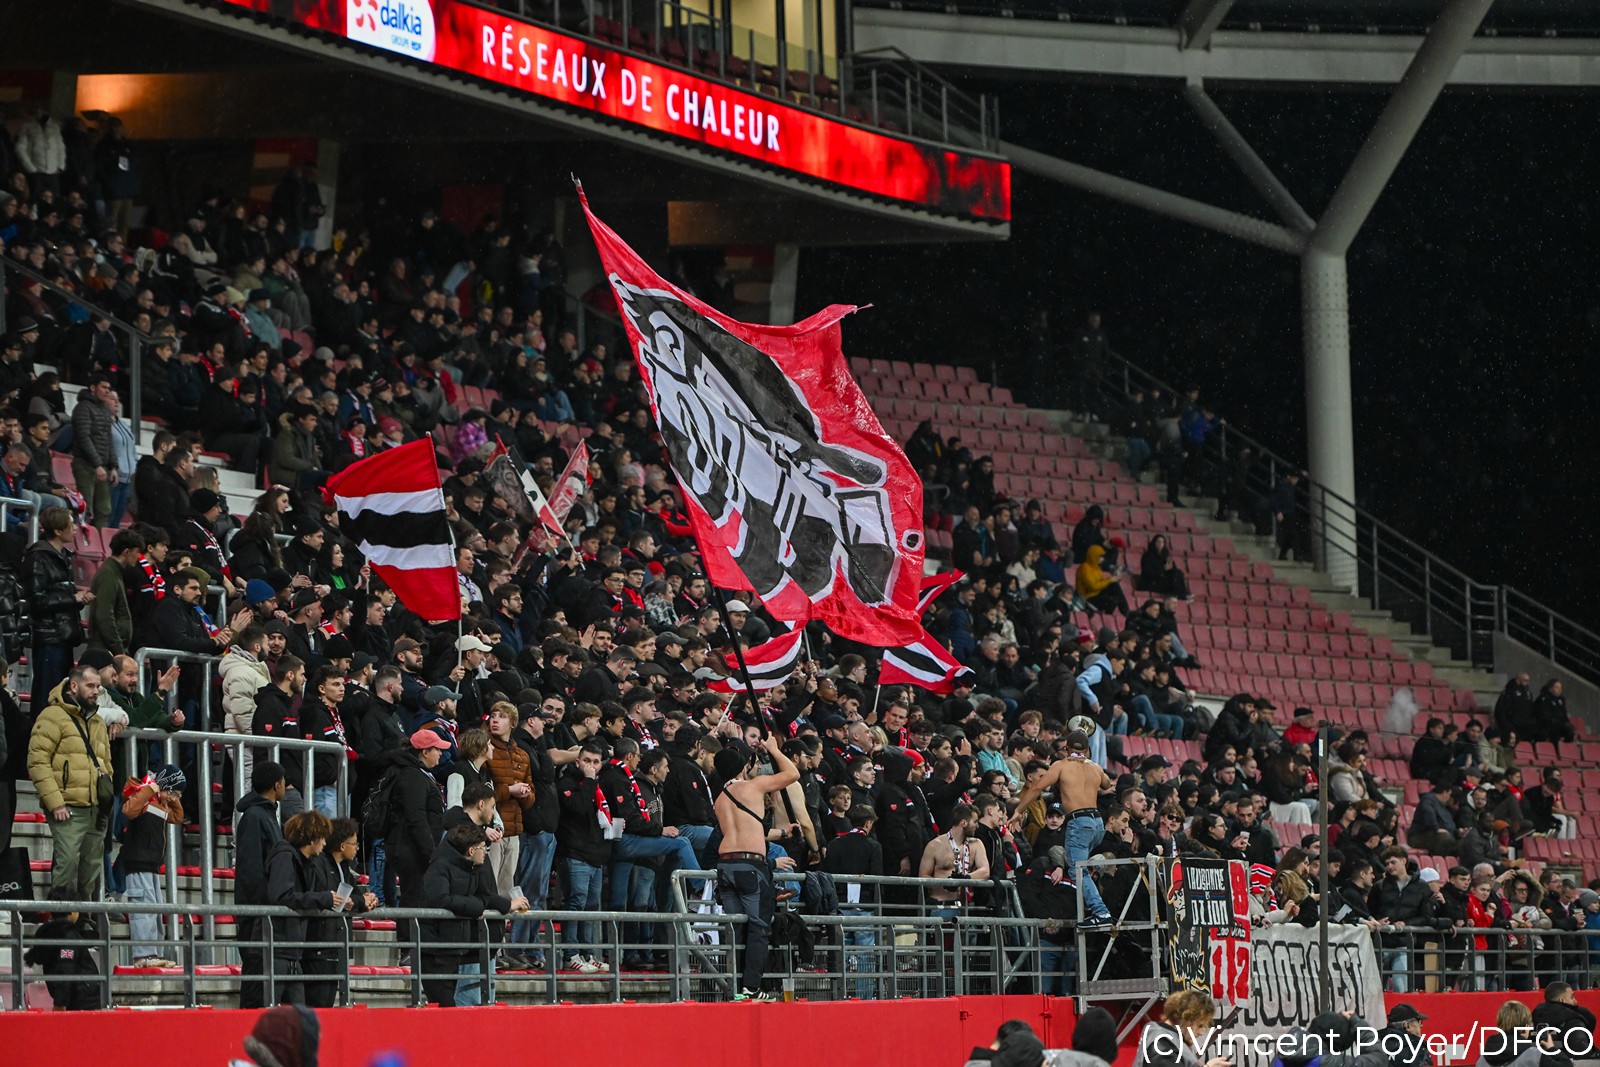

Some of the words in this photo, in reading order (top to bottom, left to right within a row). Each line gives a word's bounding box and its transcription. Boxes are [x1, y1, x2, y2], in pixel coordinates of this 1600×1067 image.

[380, 0, 422, 36] dalkia
[482, 25, 607, 99] RÉSEAUX
[621, 68, 652, 112] DE
[666, 85, 781, 152] CHALEUR
[1191, 899, 1229, 926] DIJON
